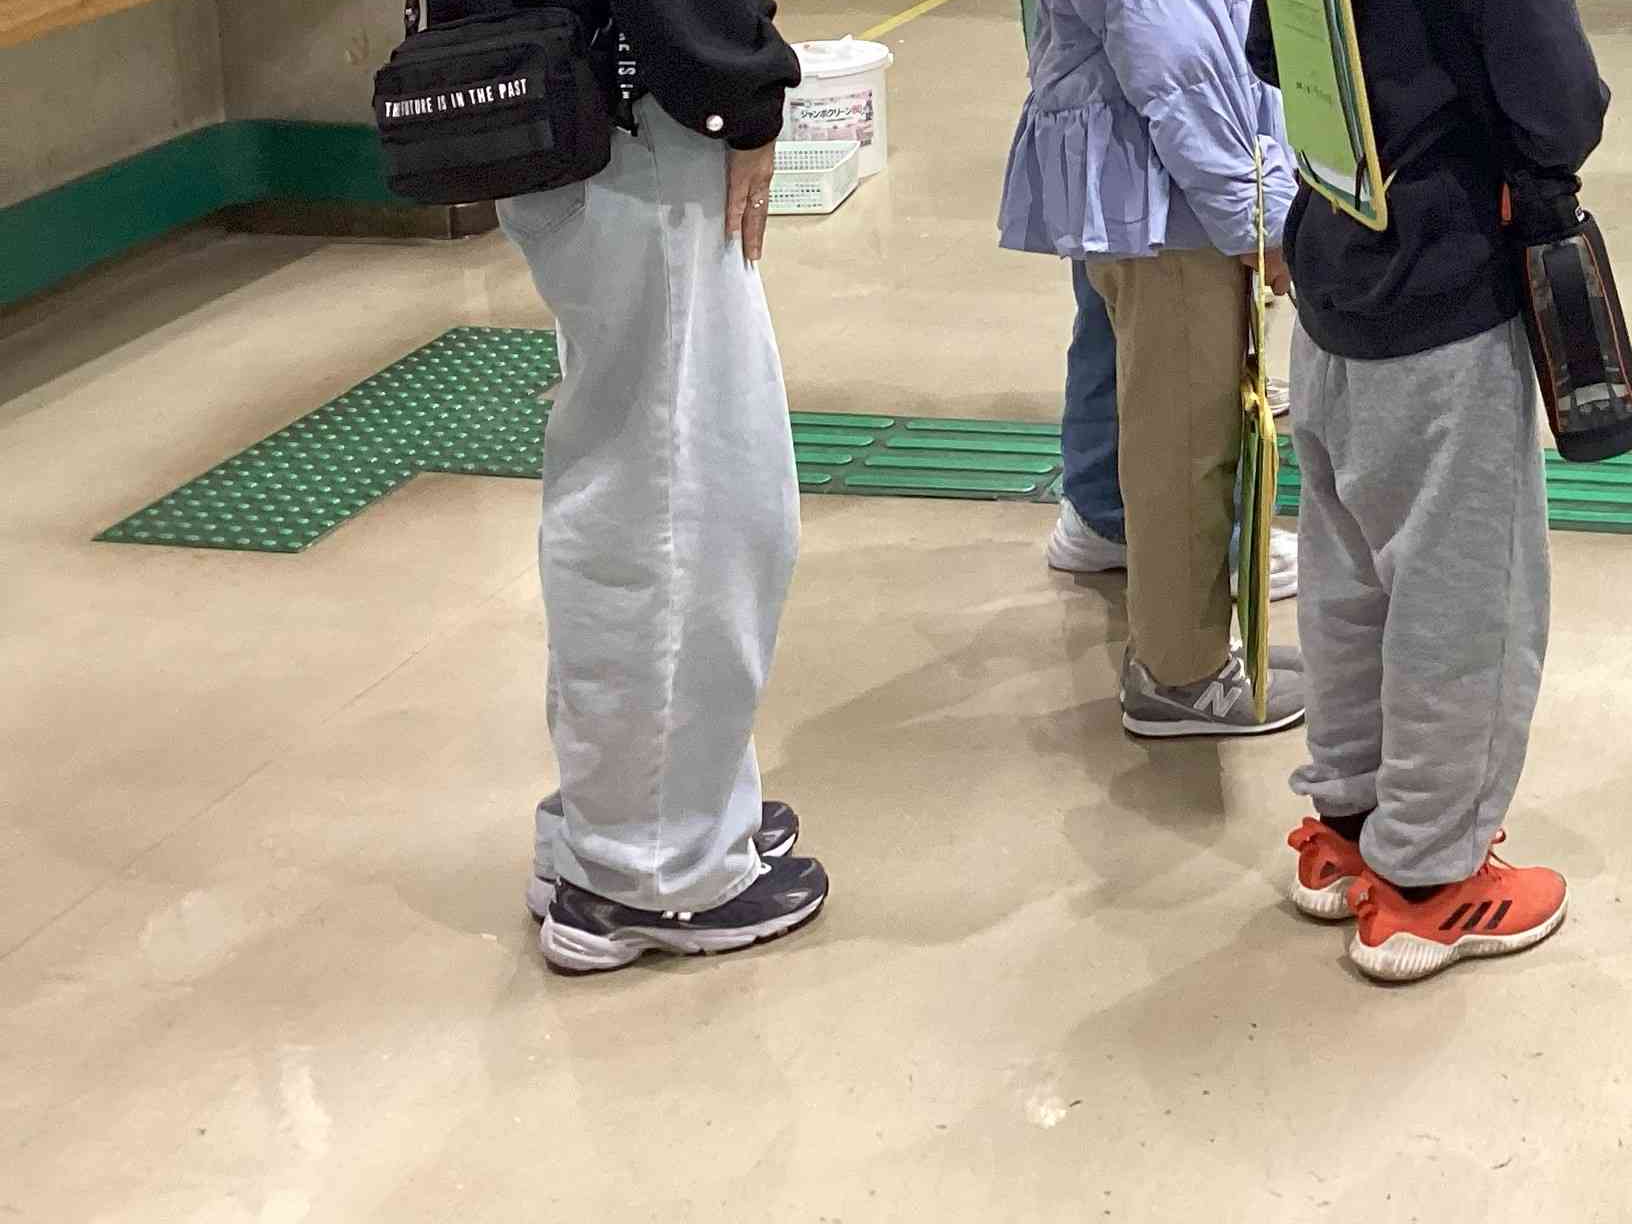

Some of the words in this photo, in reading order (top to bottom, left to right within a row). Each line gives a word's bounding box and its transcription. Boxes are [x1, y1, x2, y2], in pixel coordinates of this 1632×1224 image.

[437, 95, 447, 112] IS
[451, 92, 465, 108] IN
[468, 86, 495, 105] THE
[498, 78, 528, 100] PAST
[1193, 681, 1242, 717] N
